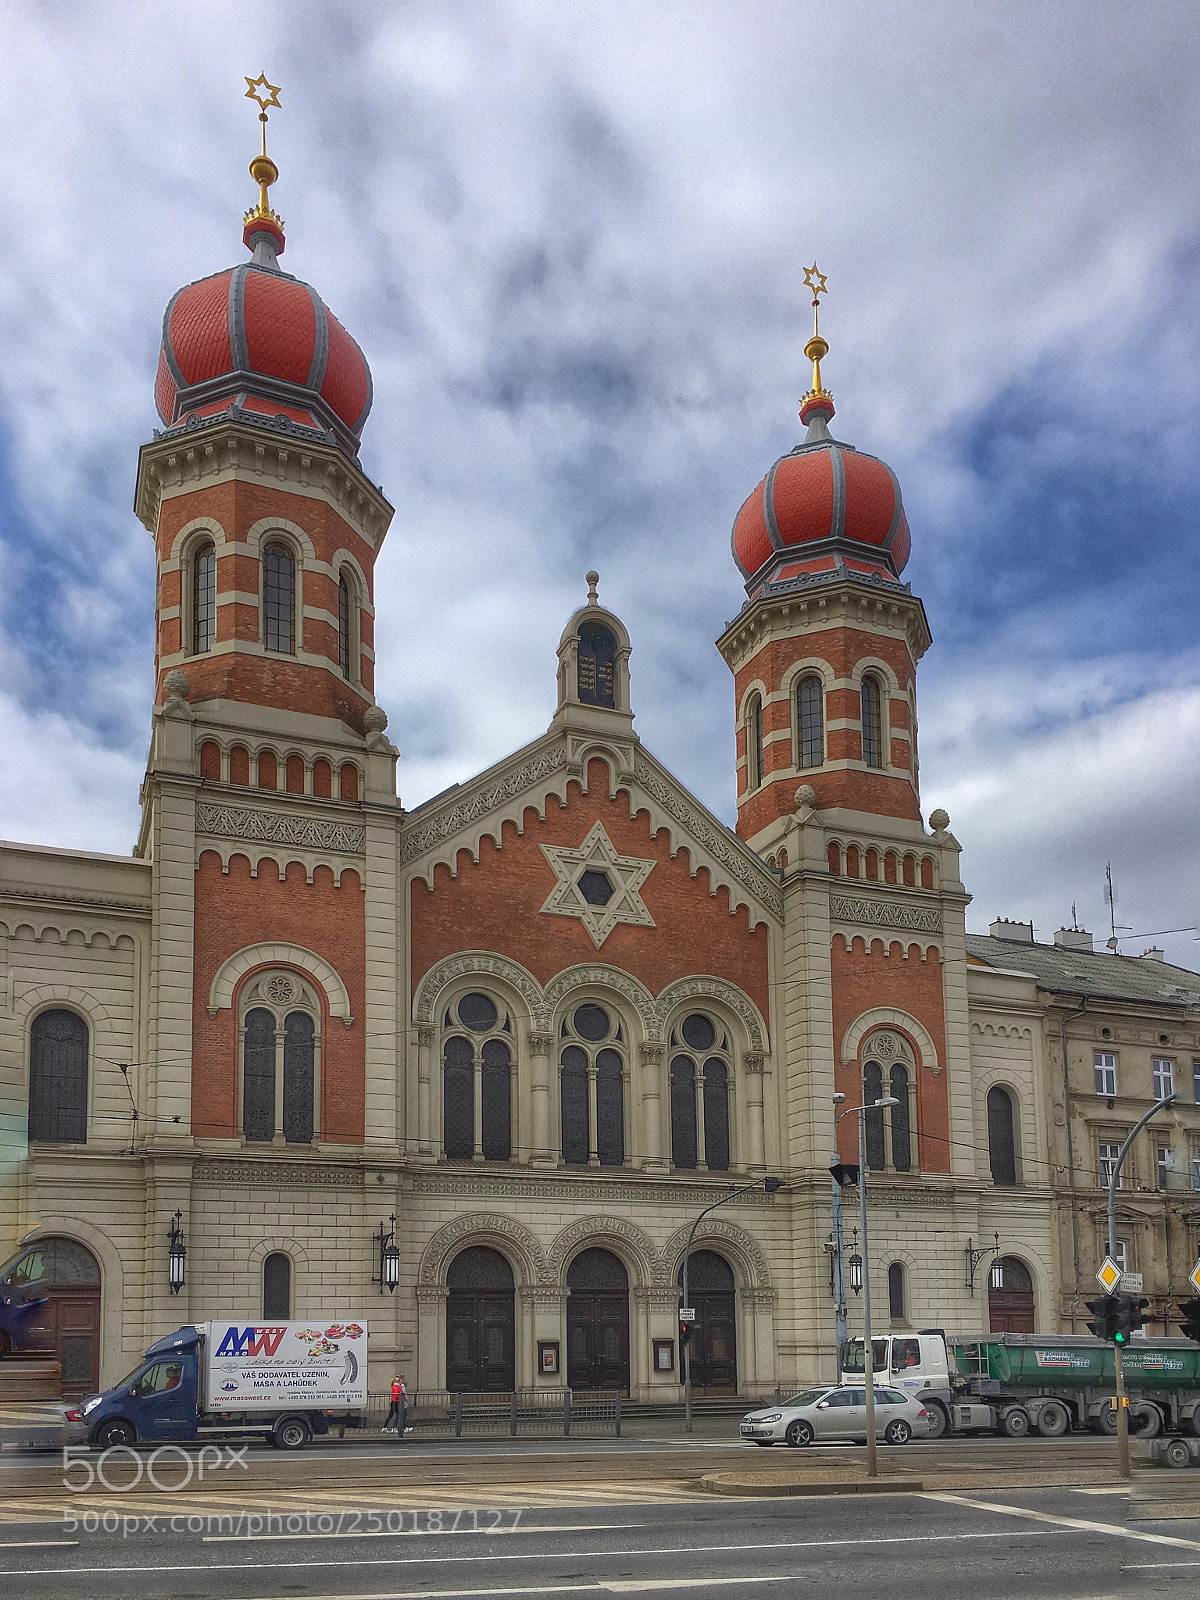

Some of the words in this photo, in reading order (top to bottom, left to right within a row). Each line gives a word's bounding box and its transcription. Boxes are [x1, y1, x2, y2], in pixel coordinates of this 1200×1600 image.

[258, 1371, 300, 1379] DODAVATEL
[253, 1380, 275, 1388] MASA
[283, 1379, 318, 1387] LAHŮDEK
